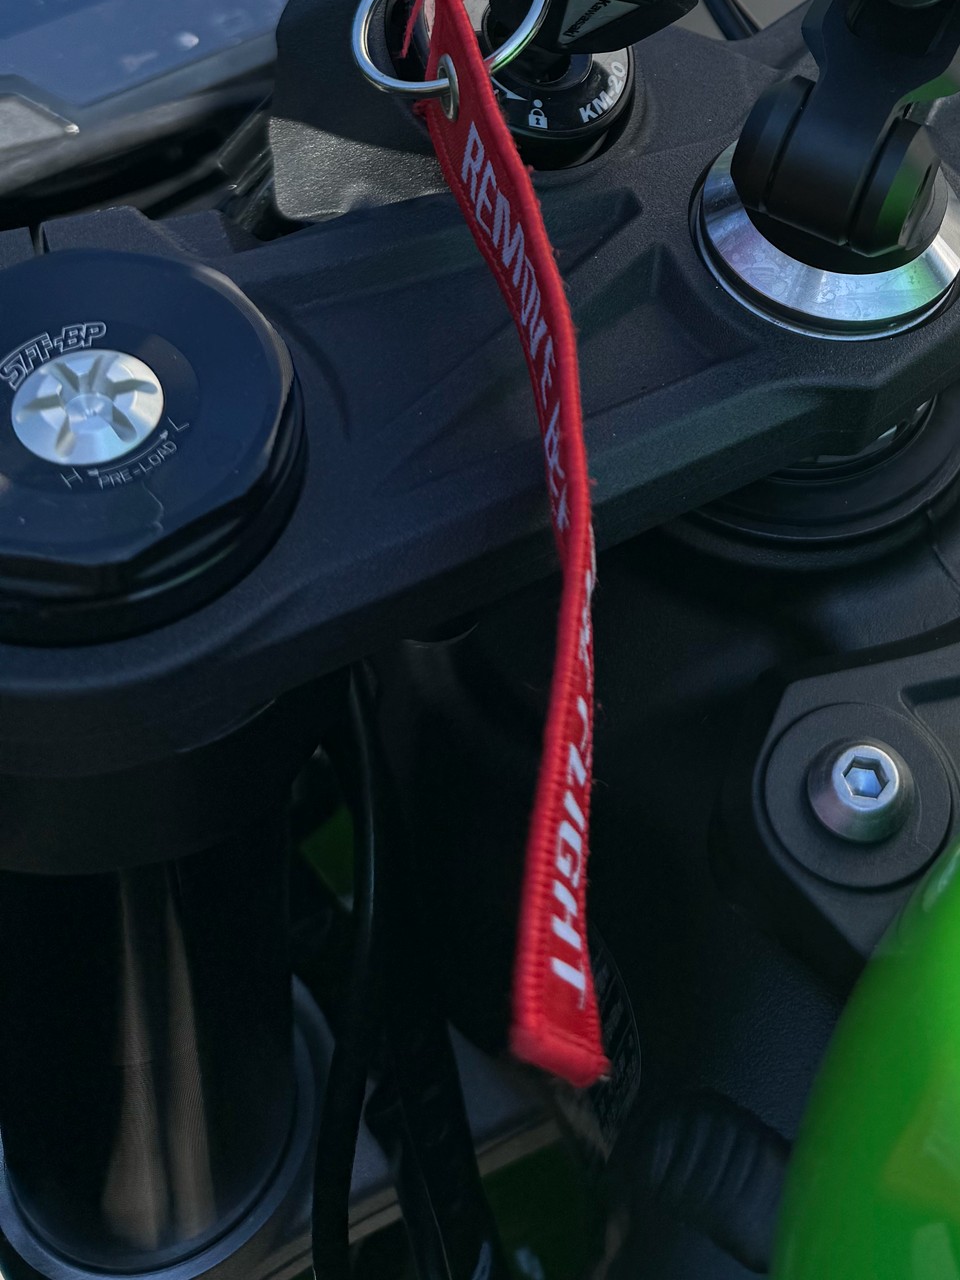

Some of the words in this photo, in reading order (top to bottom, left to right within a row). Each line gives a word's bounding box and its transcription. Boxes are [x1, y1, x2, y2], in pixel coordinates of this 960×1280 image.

[579, 61, 626, 123] KM-20
[461, 120, 558, 410] REMOVE
[0, 321, 107, 391] SFF-BP
[98, 439, 178, 490] PRE-LOAD
